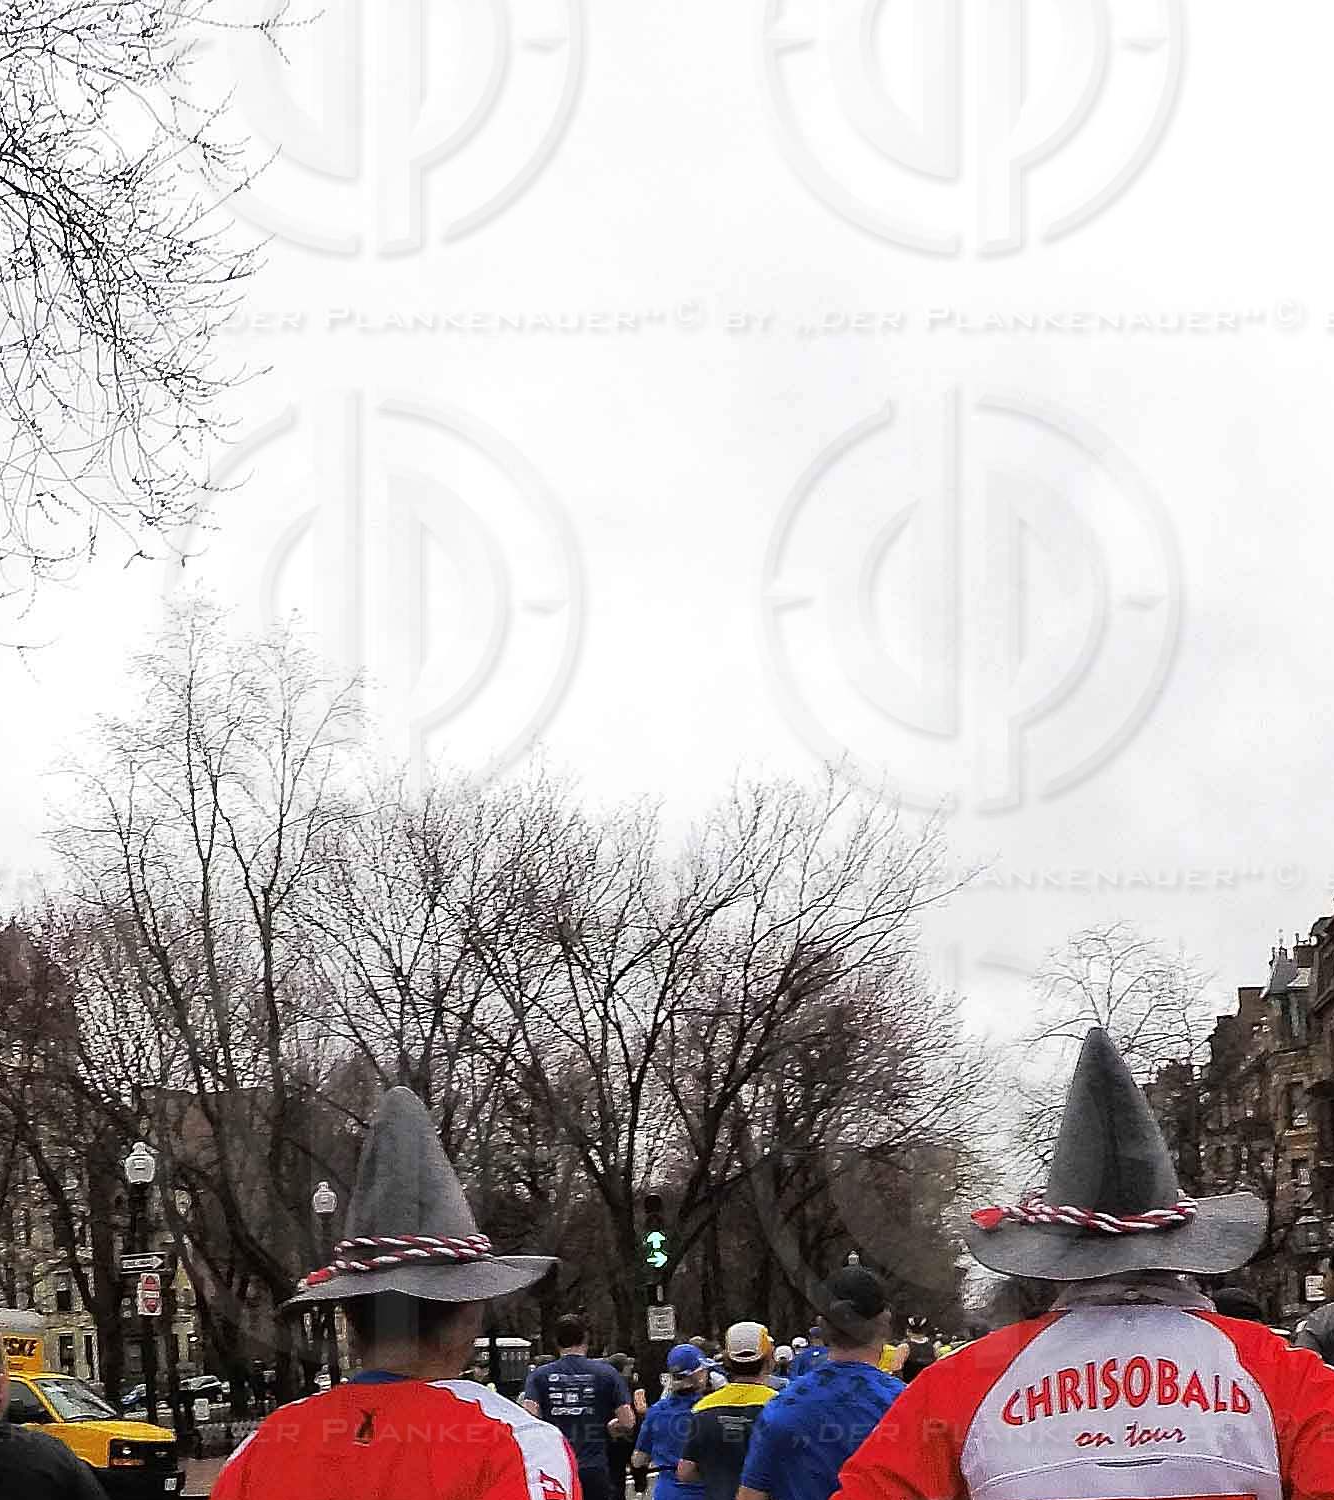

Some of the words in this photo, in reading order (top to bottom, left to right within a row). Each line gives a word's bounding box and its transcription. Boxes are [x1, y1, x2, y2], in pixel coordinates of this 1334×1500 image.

[1001, 1355, 1252, 1426] CHRISOBALD
[1074, 1429, 1115, 1448] on
[1124, 1420, 1187, 1448] tour
